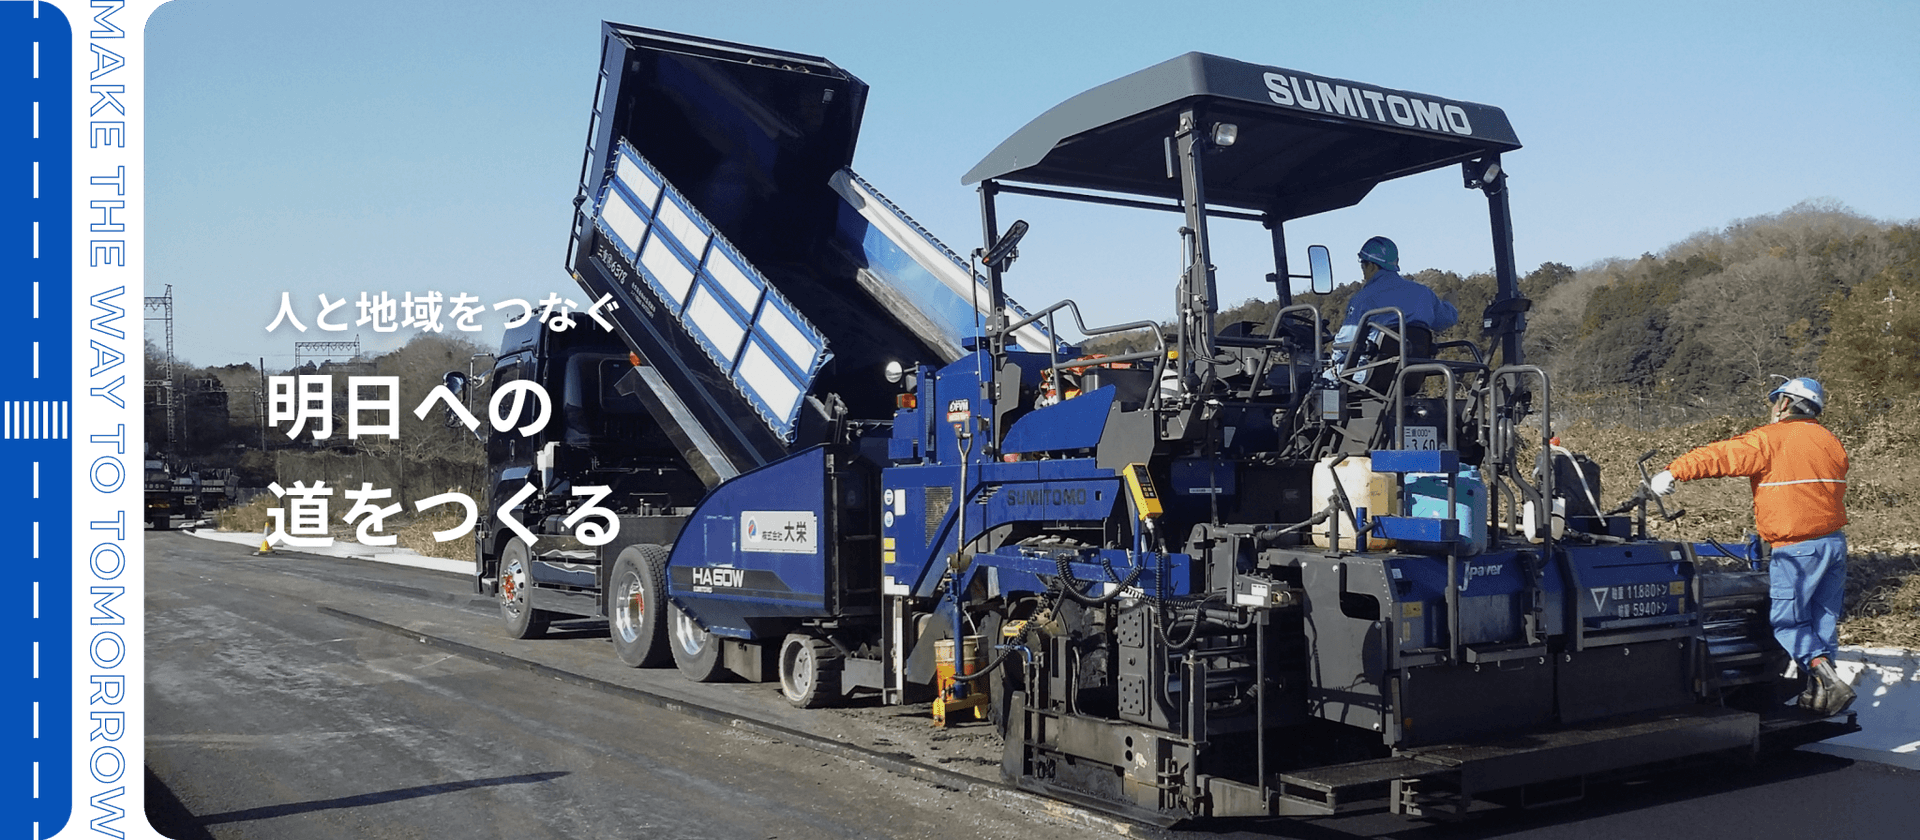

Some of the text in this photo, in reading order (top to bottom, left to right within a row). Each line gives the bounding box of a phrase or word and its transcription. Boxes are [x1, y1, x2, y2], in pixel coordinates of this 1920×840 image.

[1263, 71, 1473, 136] SUMITOMO
[1007, 488, 1087, 506] SUMITOMO
[784, 520, 808, 544] 大栄
[693, 567, 744, 588] HA60W
